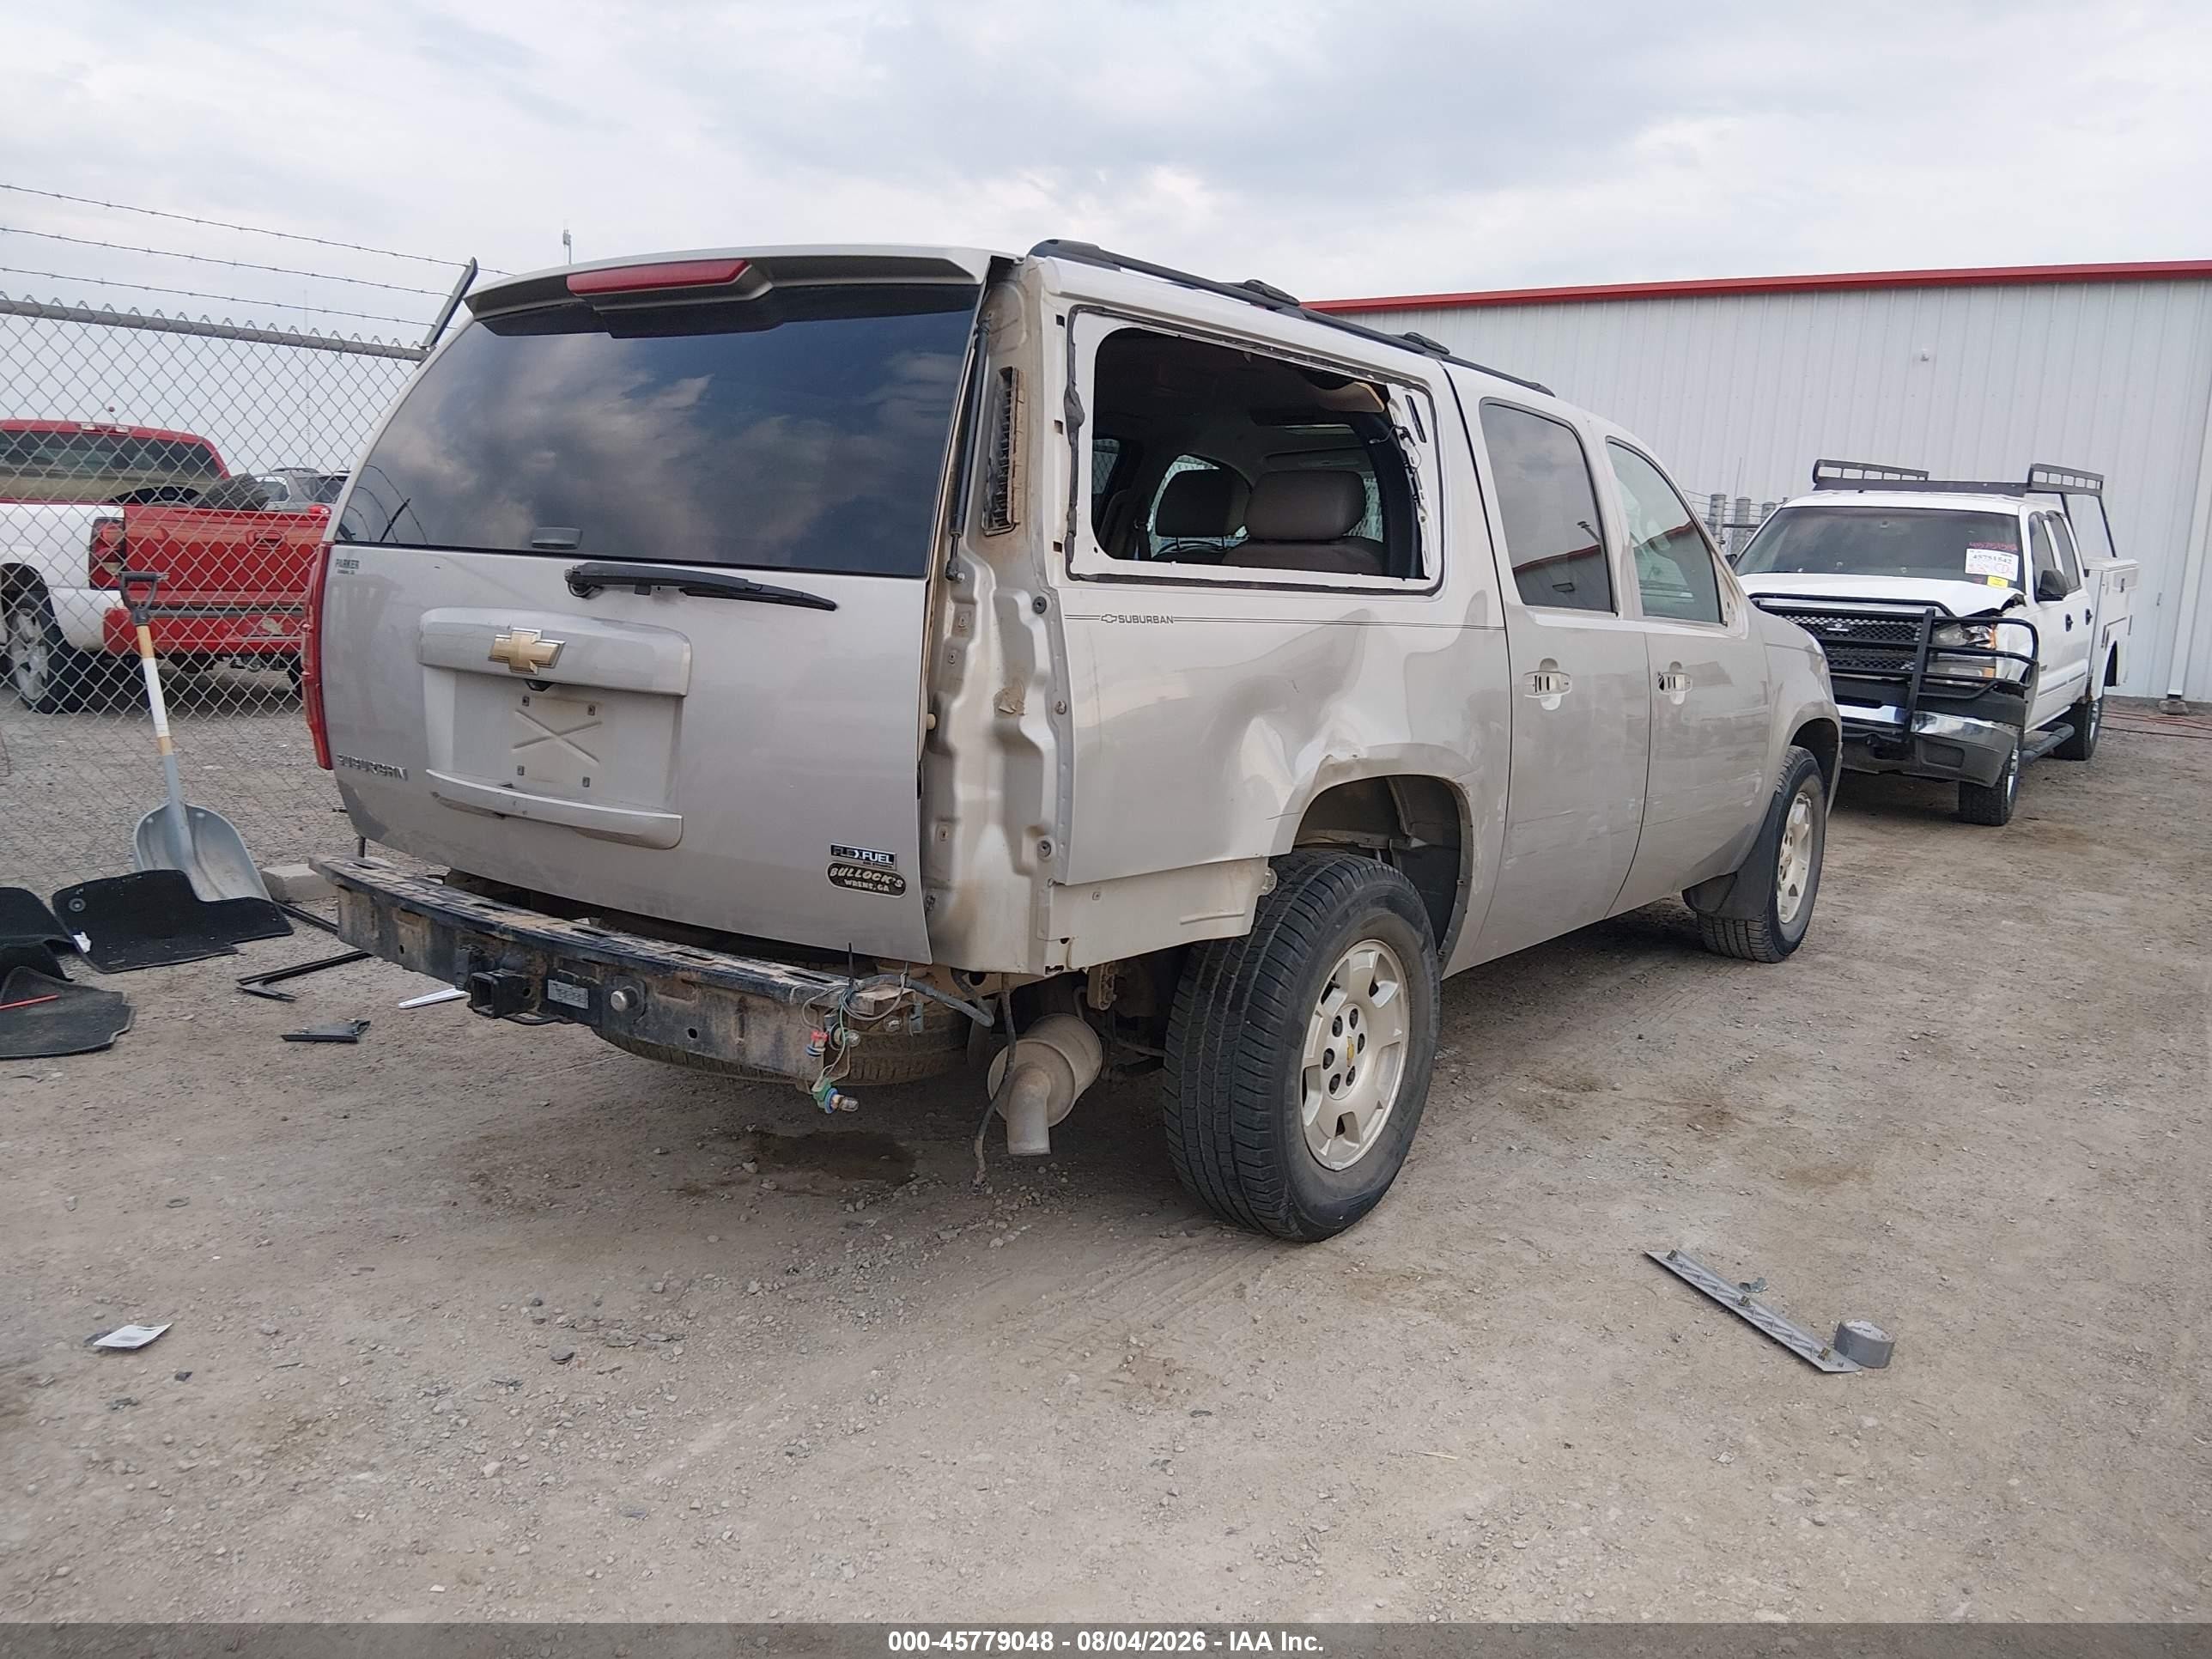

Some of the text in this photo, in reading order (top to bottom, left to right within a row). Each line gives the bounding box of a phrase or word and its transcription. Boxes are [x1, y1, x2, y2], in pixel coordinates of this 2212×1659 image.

[1118, 614, 1174, 623] SUBURBAN
[830, 867, 903, 888] BULLOCK'S
[877, 884, 890, 892] GA
